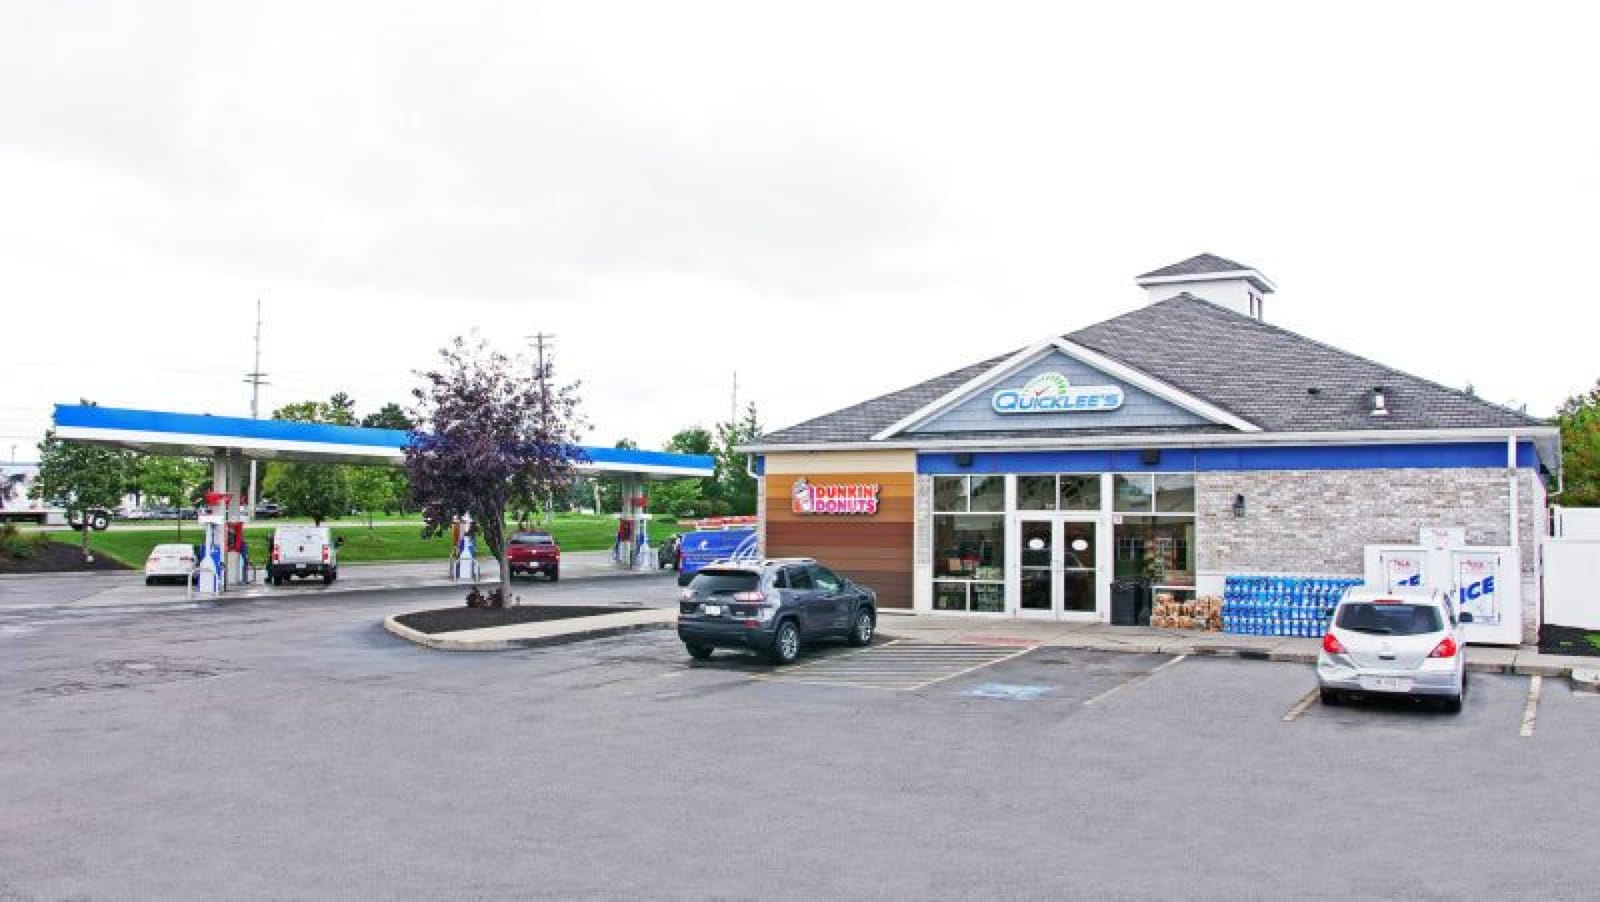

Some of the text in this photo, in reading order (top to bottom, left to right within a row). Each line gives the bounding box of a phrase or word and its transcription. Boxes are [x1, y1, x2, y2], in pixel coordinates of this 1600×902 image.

[996, 391, 1119, 409] QUICKLEE'S
[815, 484, 878, 498] DUNKIN'
[815, 499, 875, 512] DONUTS
[1460, 576, 1494, 604] ICE
